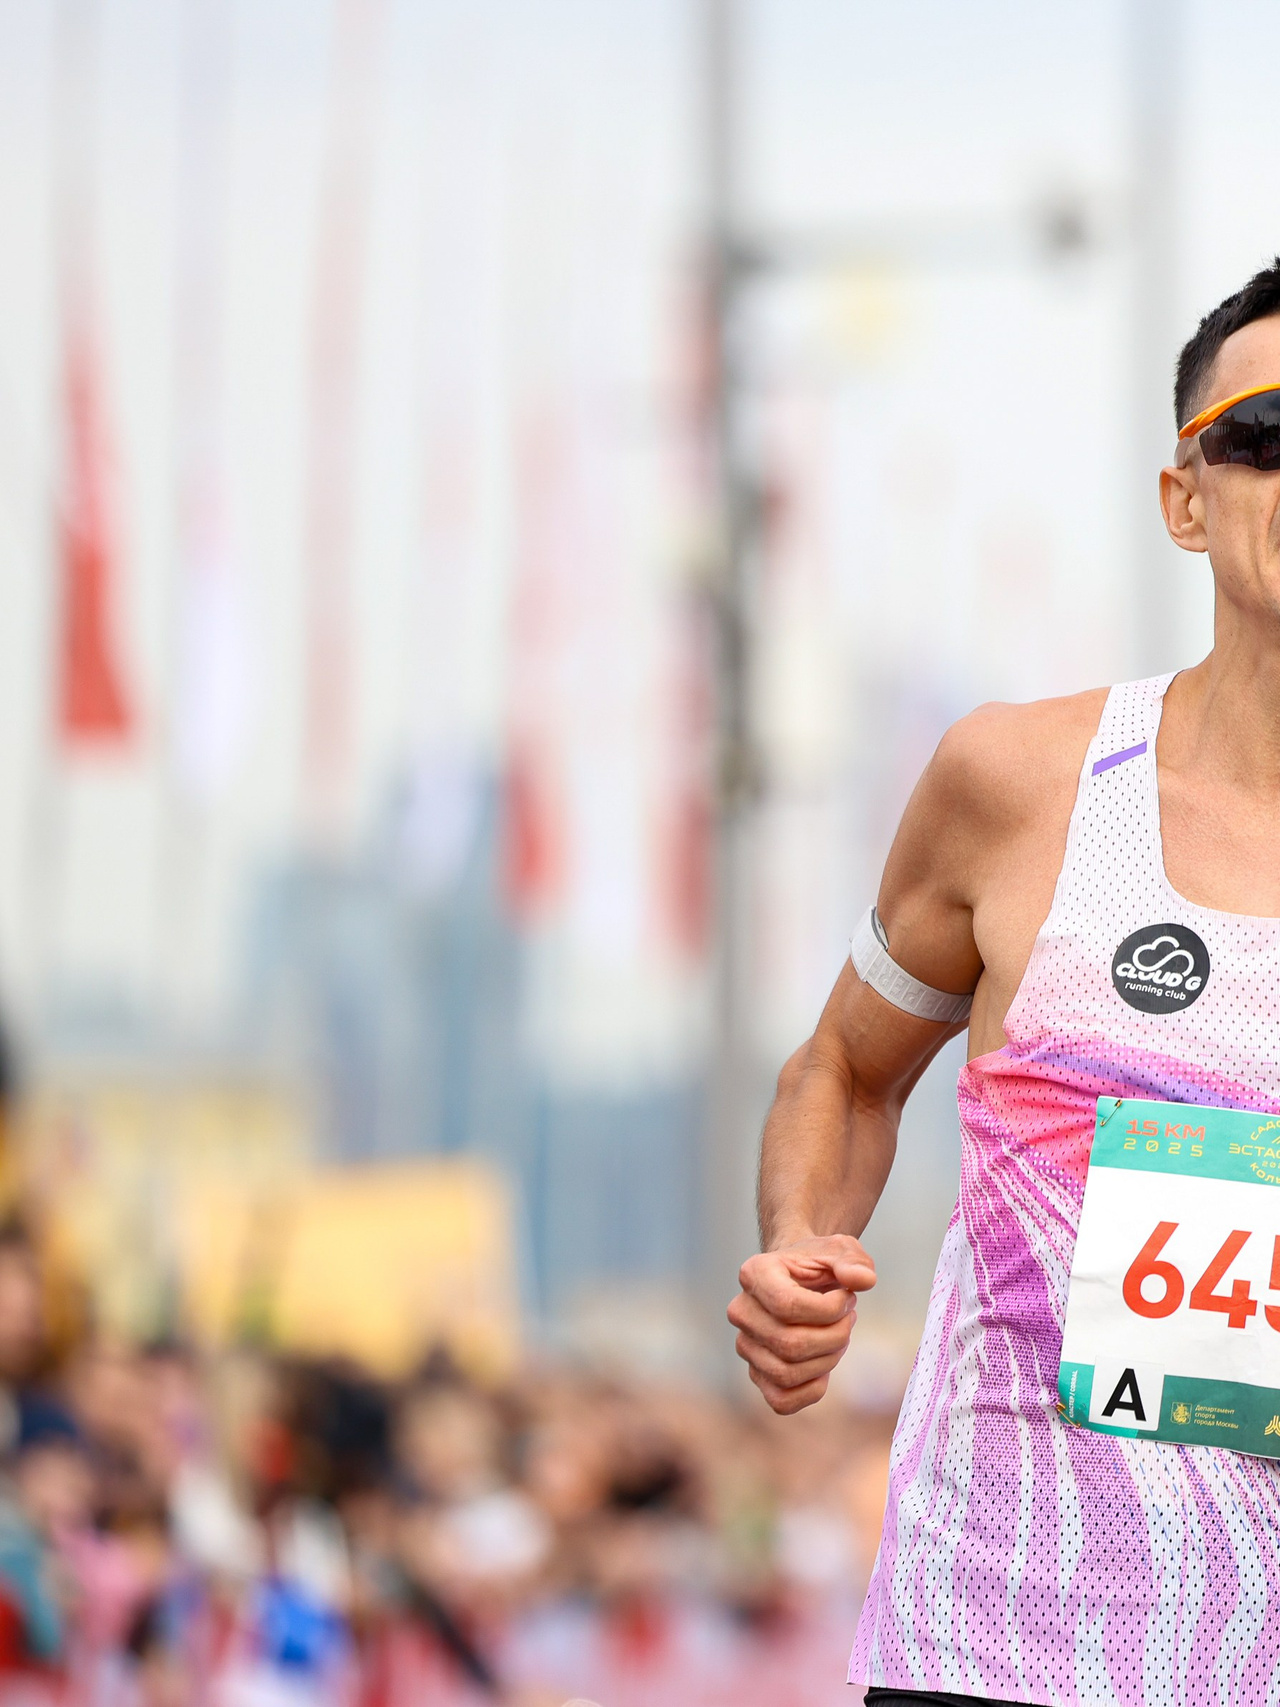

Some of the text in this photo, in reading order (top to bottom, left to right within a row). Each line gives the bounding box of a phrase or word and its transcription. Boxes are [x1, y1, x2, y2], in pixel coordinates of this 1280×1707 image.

[1125, 981, 1187, 1001] running club
[1125, 1119, 1159, 1137] 15
[1123, 1137, 1204, 1158] 2025
[1194, 1404, 1236, 1415] Департамент
[1194, 1412, 1216, 1420] спорта
[1193, 1418, 1239, 1429] города Москвы
